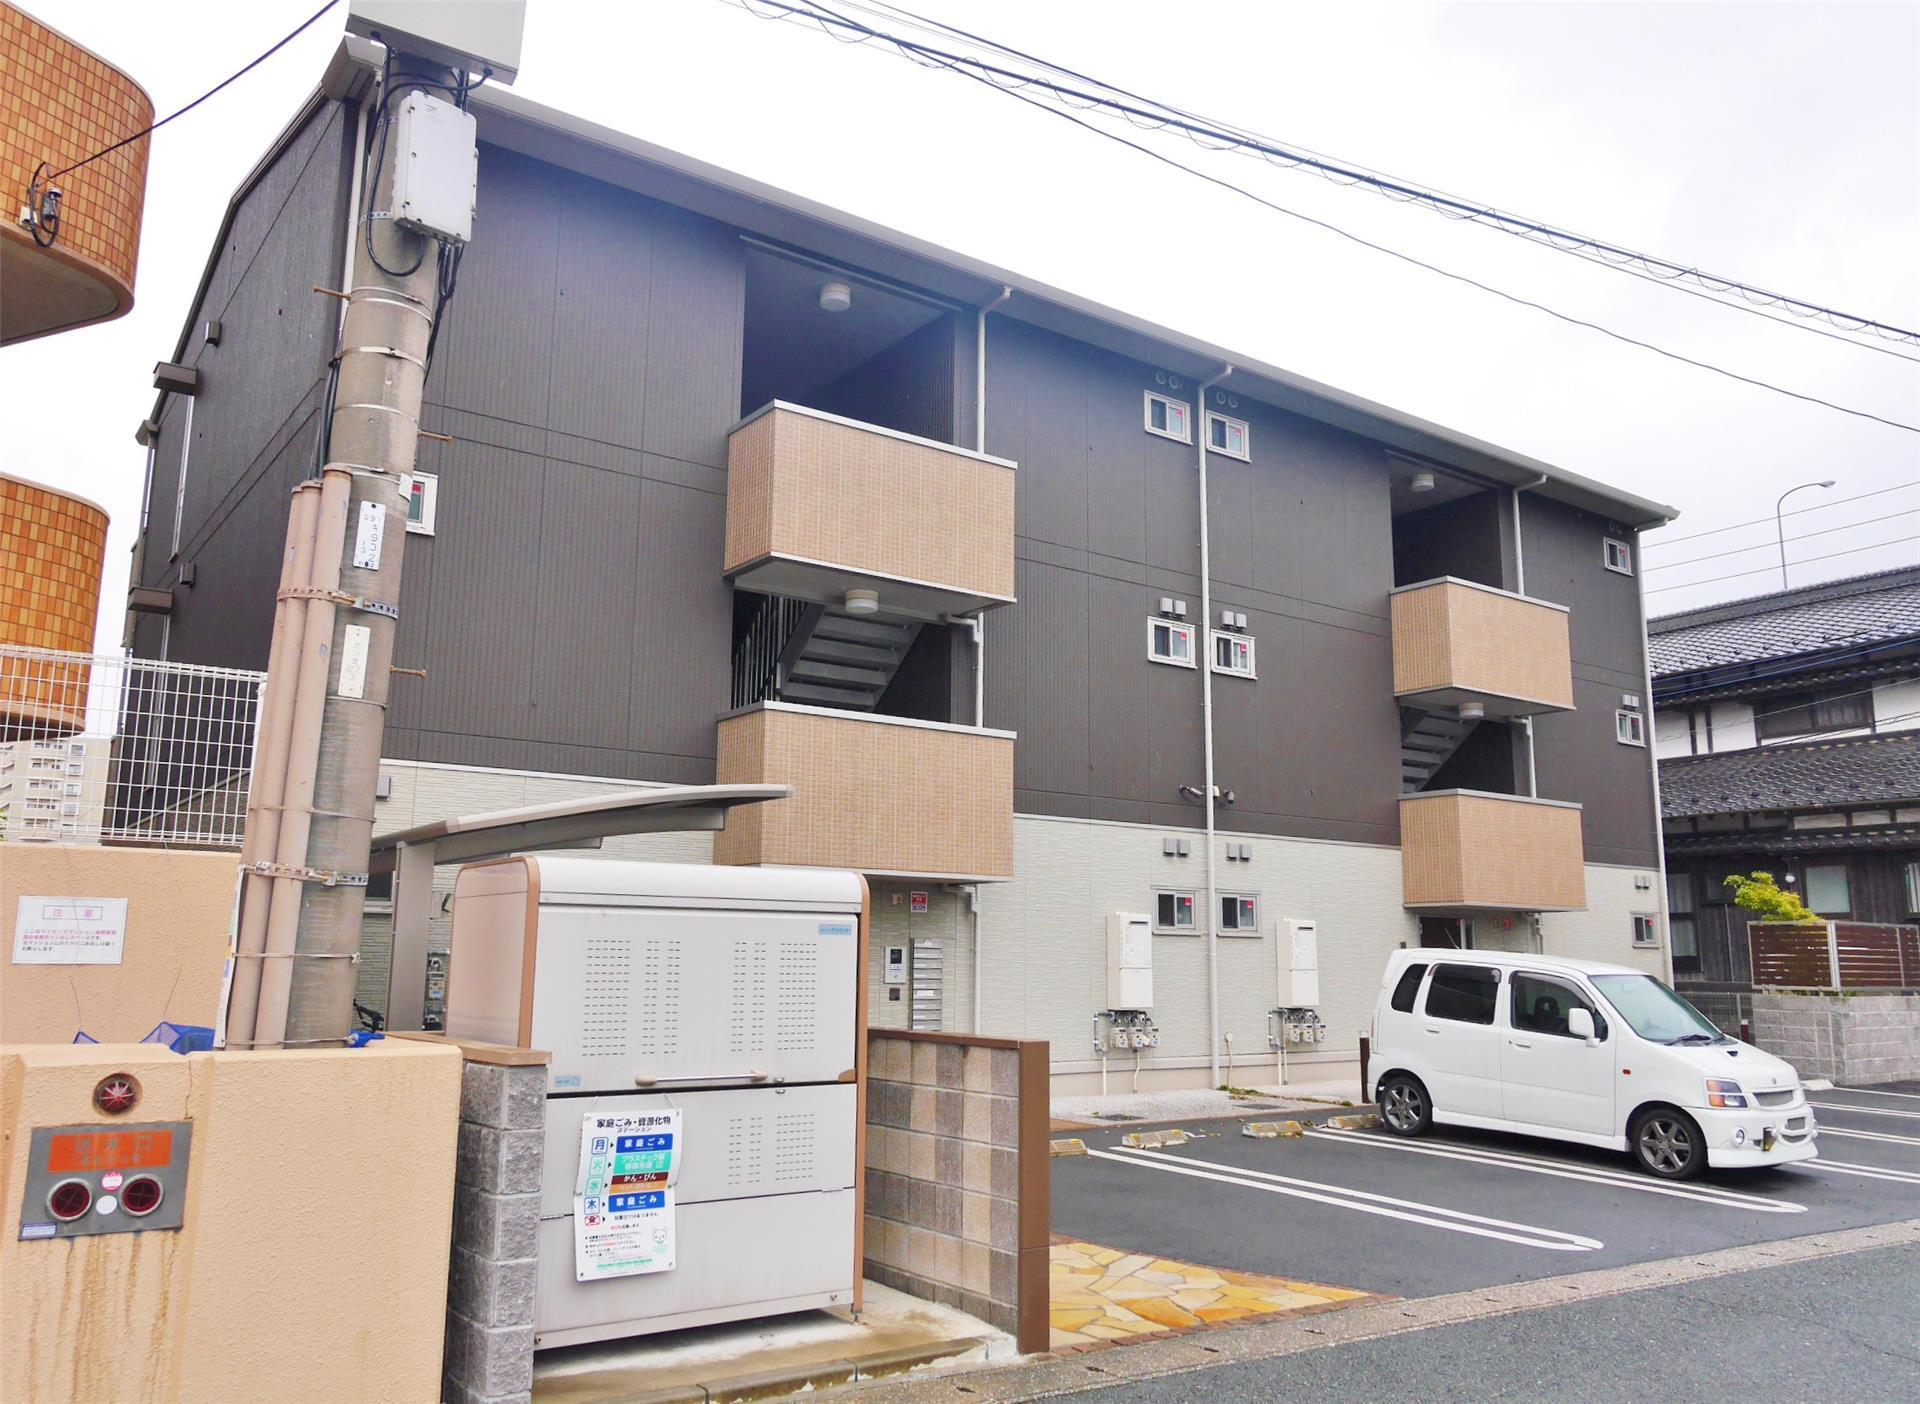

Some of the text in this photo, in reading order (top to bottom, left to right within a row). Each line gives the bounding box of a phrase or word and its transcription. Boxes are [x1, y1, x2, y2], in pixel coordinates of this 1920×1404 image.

[596, 1116, 671, 1129] 家庭ごみ・資源化物
[594, 1139, 605, 1151] 月
[624, 1138, 666, 1148] 家庭ごみ
[615, 1195, 657, 1207] 家庭ごみ
